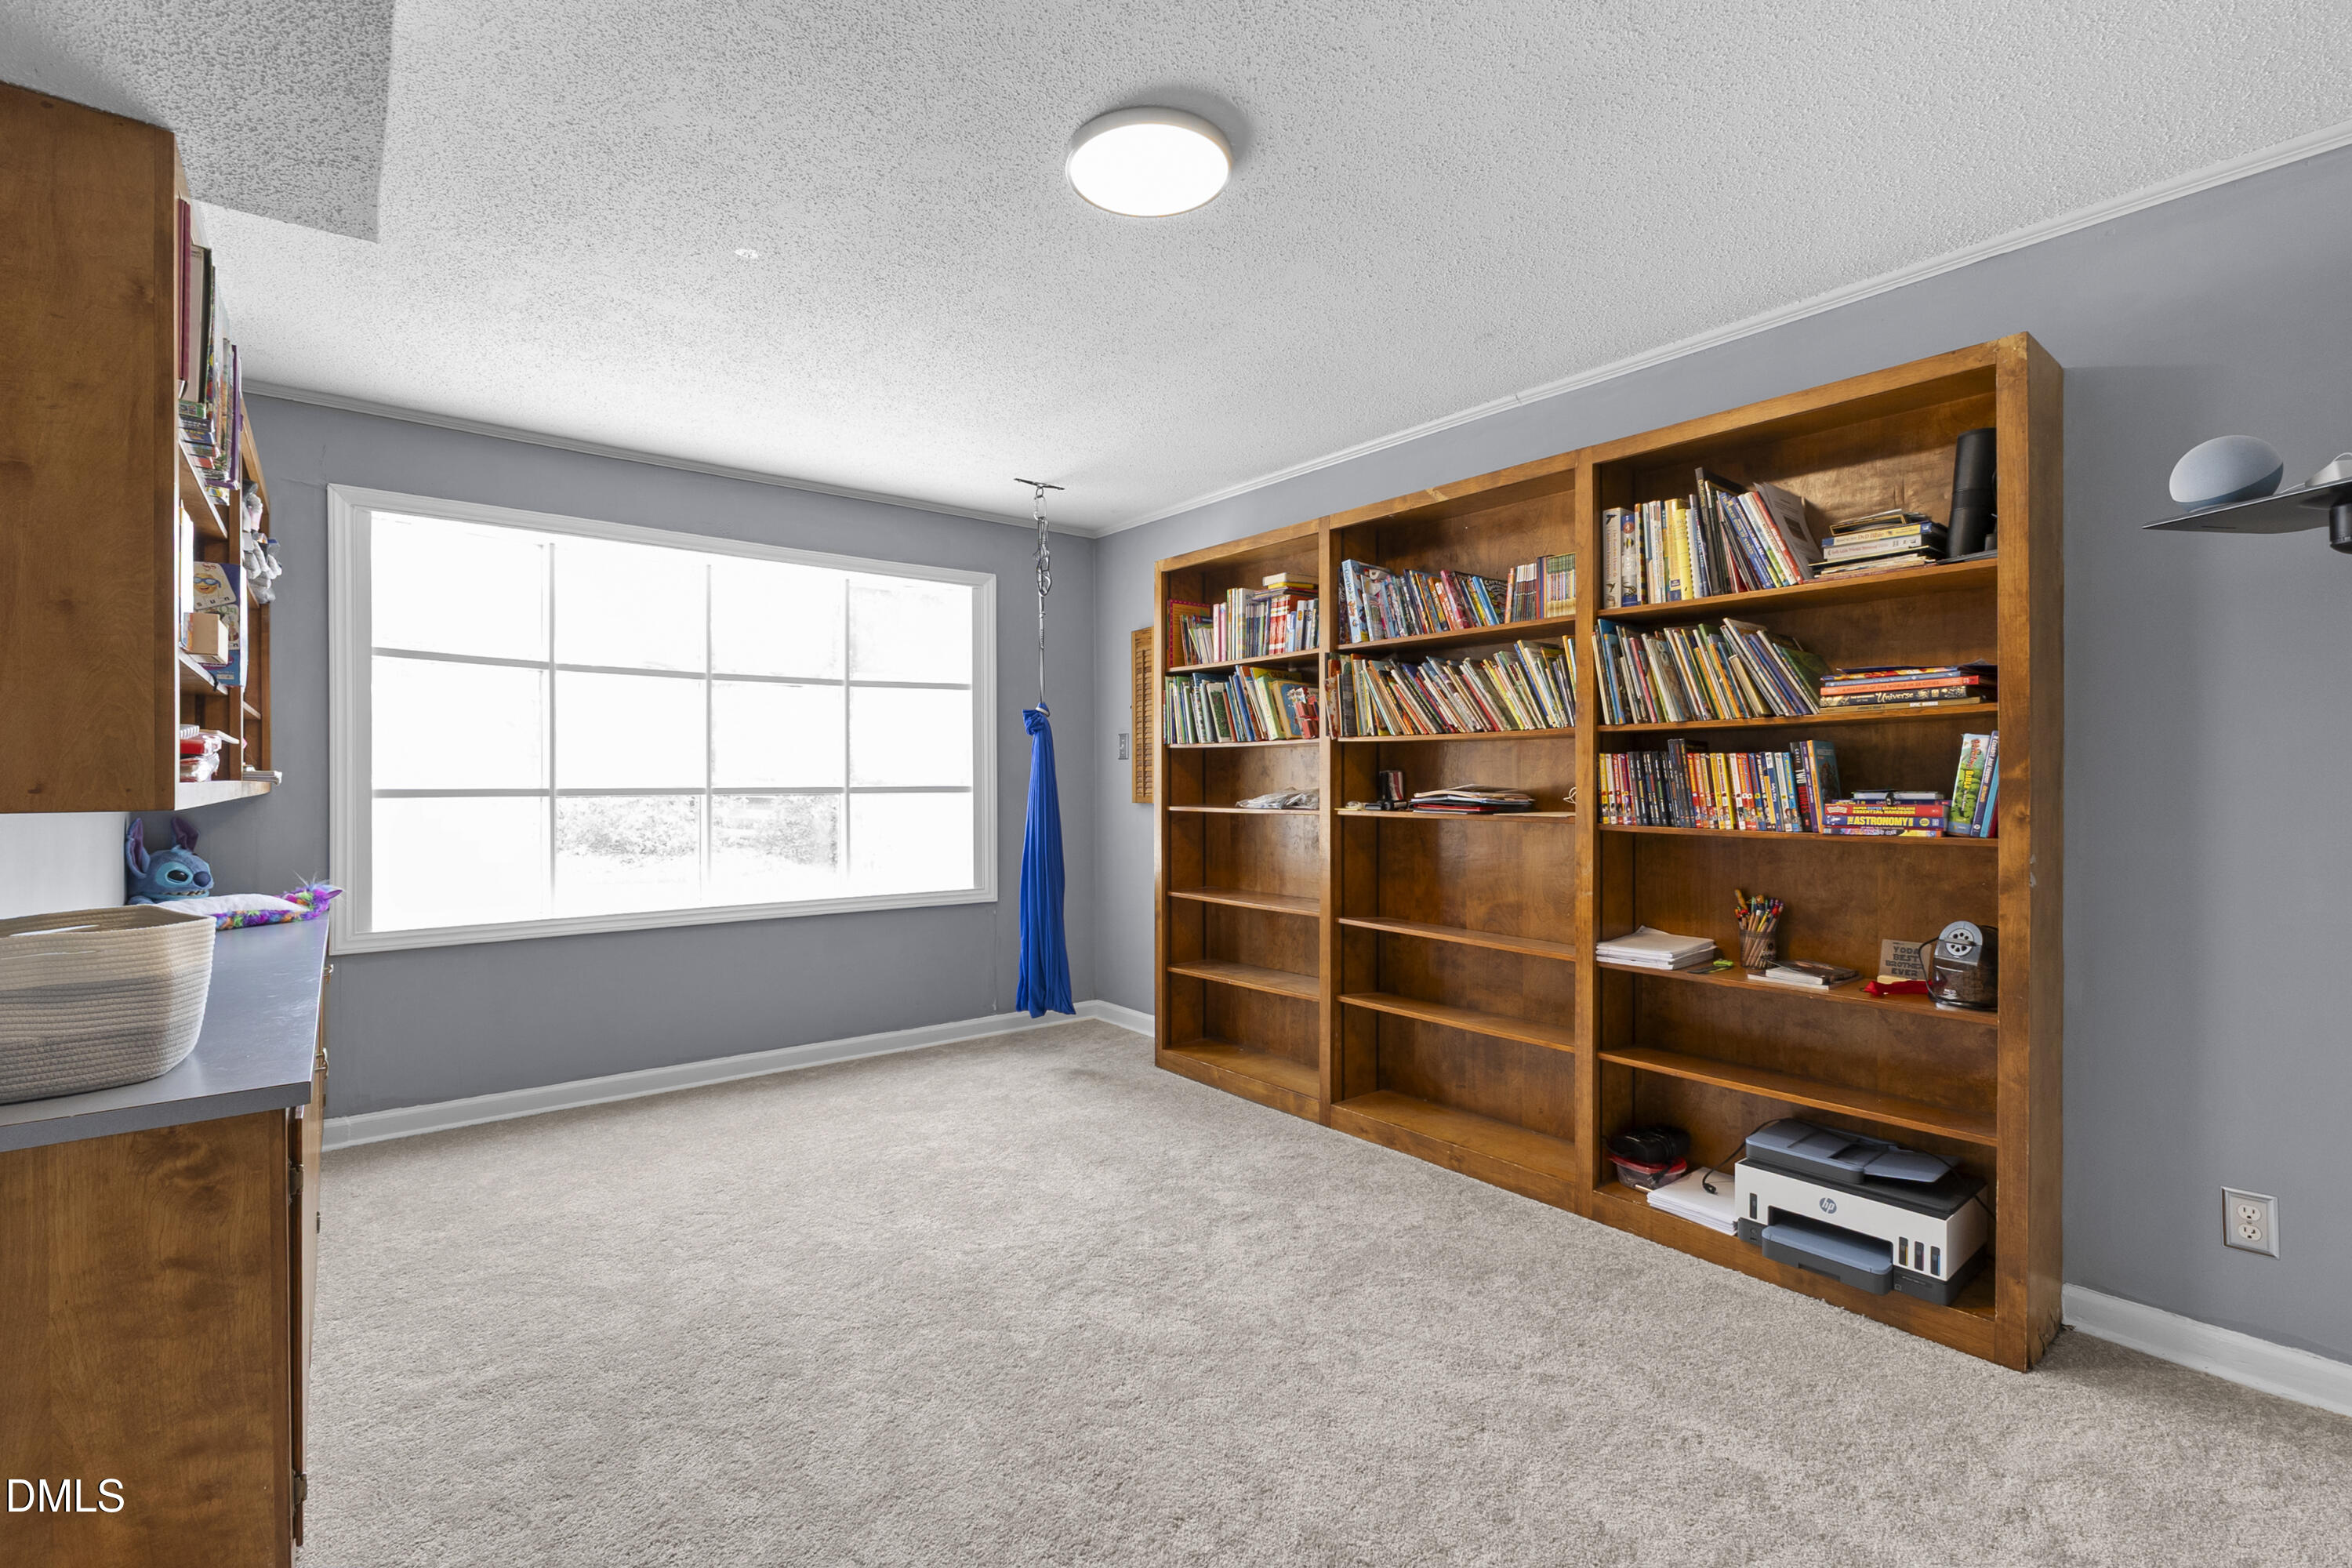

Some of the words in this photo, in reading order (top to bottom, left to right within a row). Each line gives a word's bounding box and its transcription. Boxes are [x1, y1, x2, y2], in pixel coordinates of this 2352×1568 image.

[1875, 691, 1914, 703] Universe
[1795, 768, 1807, 784] TWO
[1853, 816, 1909, 826] ASTRONOMY
[1893, 946, 1920, 955] YODA
[1893, 953, 1919, 962] BEST
[1891, 967, 1918, 976] EVER
[1821, 1198, 1836, 1214] hp
